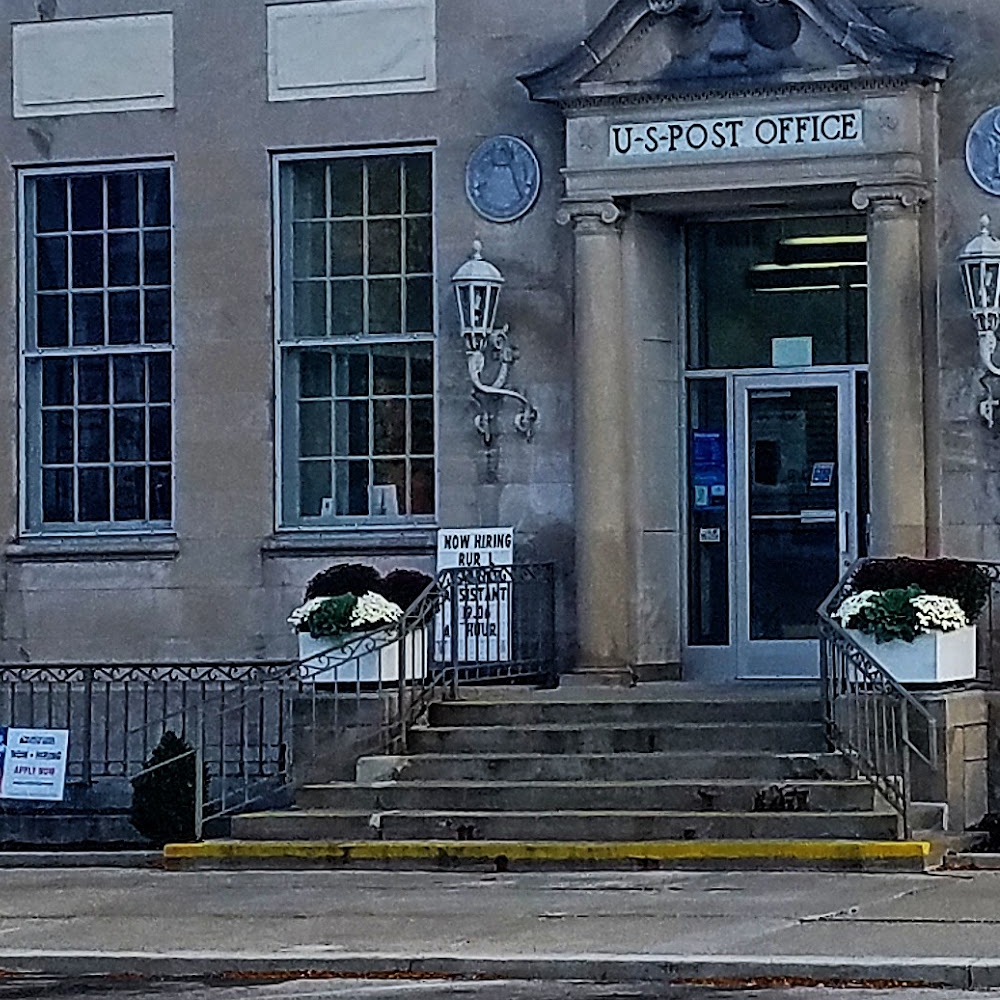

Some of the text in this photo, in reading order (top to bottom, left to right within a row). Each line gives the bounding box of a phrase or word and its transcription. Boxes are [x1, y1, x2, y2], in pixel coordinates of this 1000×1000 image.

[755, 113, 859, 146] OFFICE
[444, 533, 512, 550] NOW HIRING
